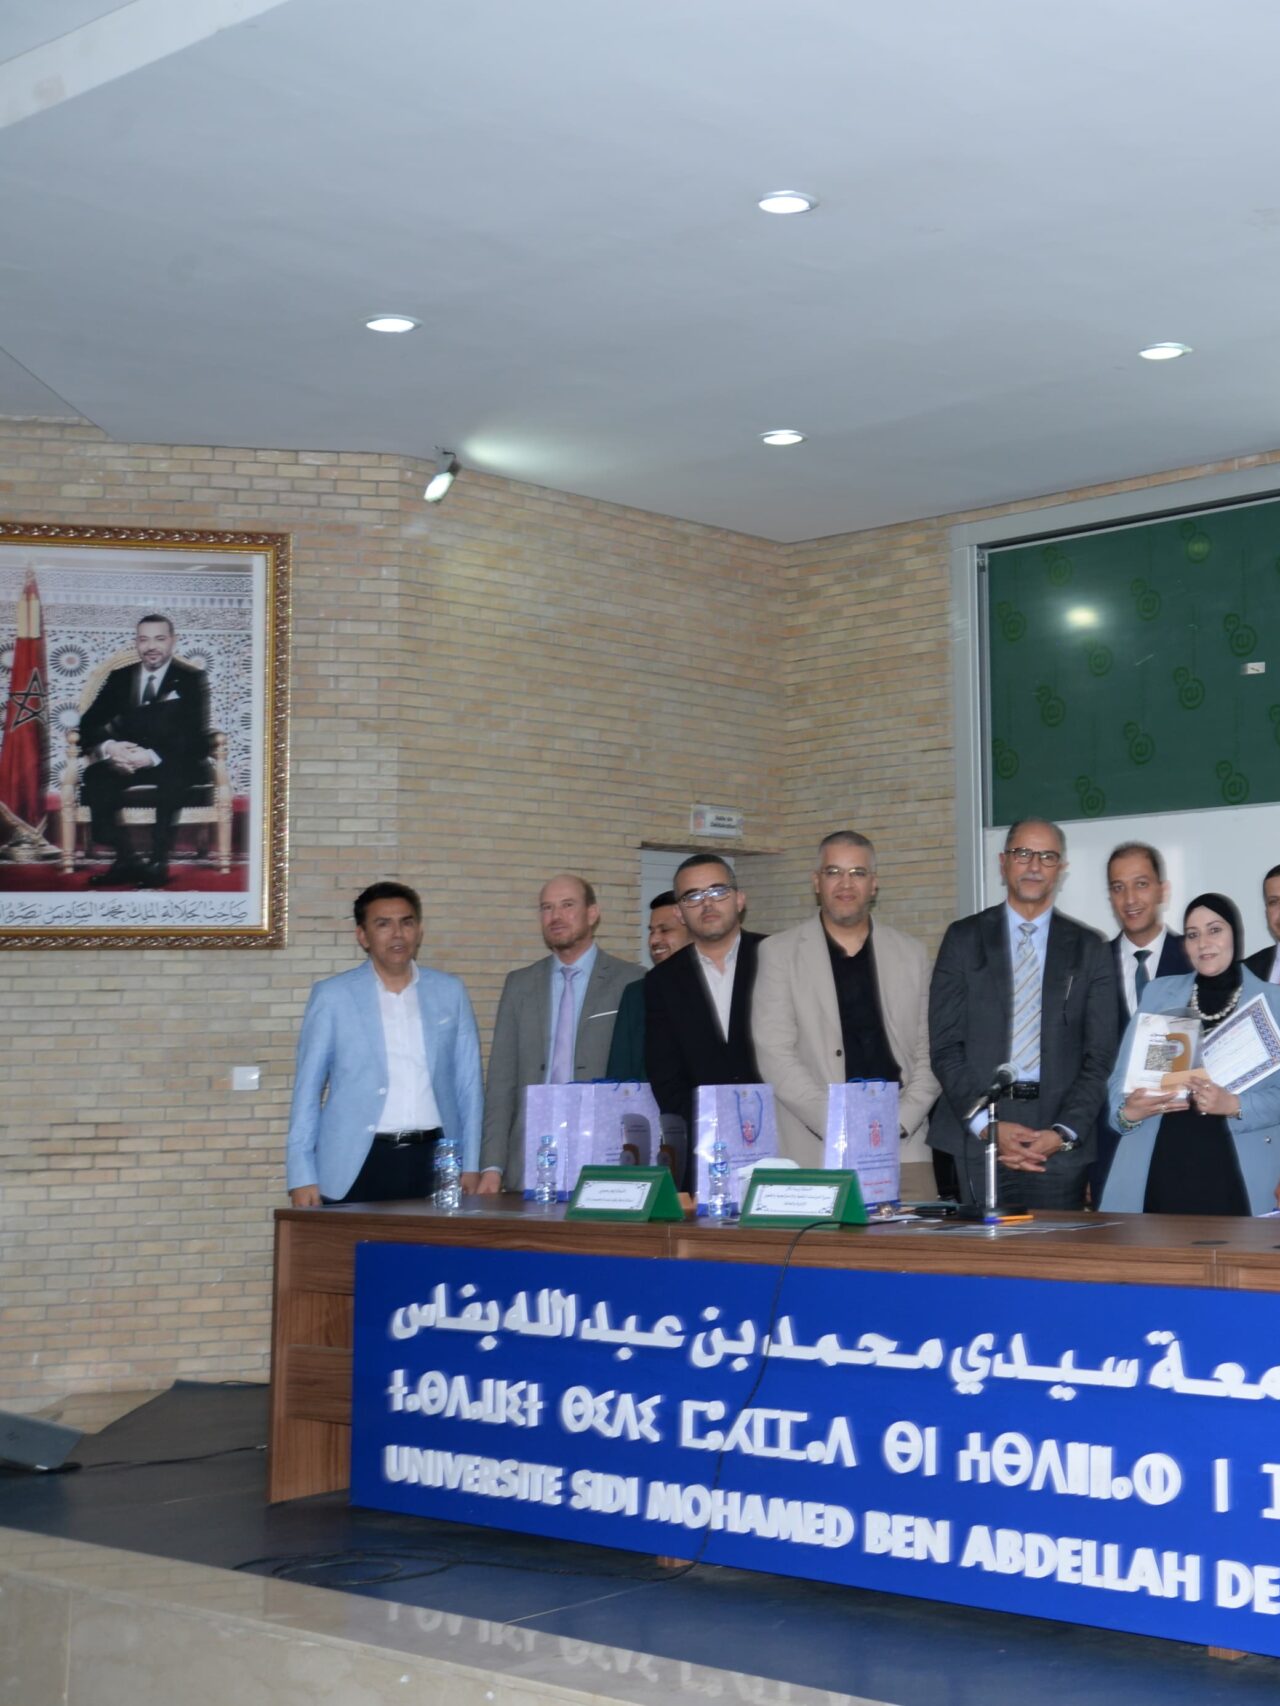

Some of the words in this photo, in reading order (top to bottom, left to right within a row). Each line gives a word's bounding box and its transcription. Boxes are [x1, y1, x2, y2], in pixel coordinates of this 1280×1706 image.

[393, 1284, 499, 1350] بفاس
[503, 1289, 576, 1336] الله
[581, 1302, 685, 1360] عبد
[691, 1307, 755, 1371] بن
[762, 1316, 943, 1369] محمد
[950, 1333, 1138, 1400] سيدي
[386, 1446, 562, 1505] UNIVERSITE
[570, 1470, 638, 1515] SIDI
[646, 1482, 854, 1547] MOHAMED
[865, 1511, 950, 1563] BEN
[960, 1525, 1200, 1601] ABDELLAH
[1216, 1560, 1280, 1615] DE
